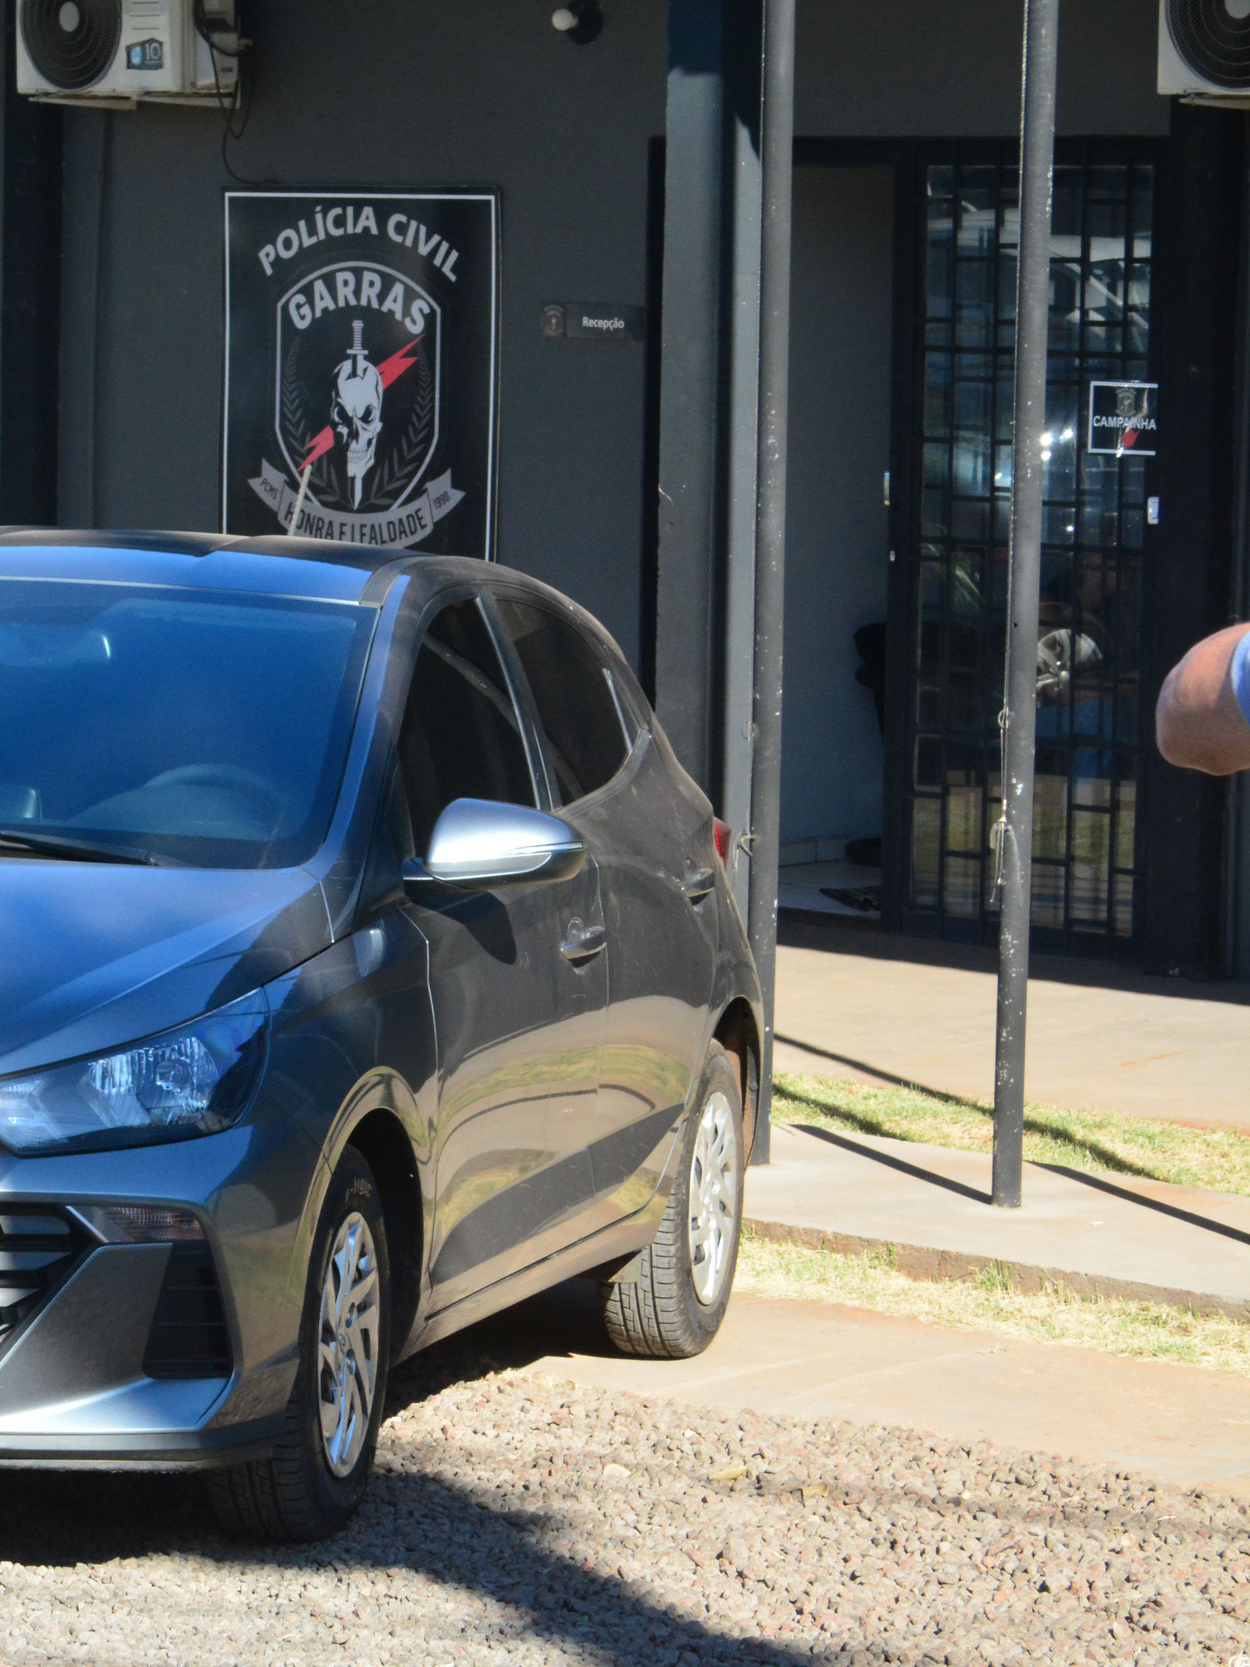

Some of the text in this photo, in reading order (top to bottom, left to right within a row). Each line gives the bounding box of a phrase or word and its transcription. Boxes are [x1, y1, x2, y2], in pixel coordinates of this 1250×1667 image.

[258, 205, 460, 283] POLÍCIA CIVIL
[288, 270, 431, 335] GARRAS
[582, 316, 625, 331] Recepção
[1093, 415, 1157, 430] CAMPAINHA
